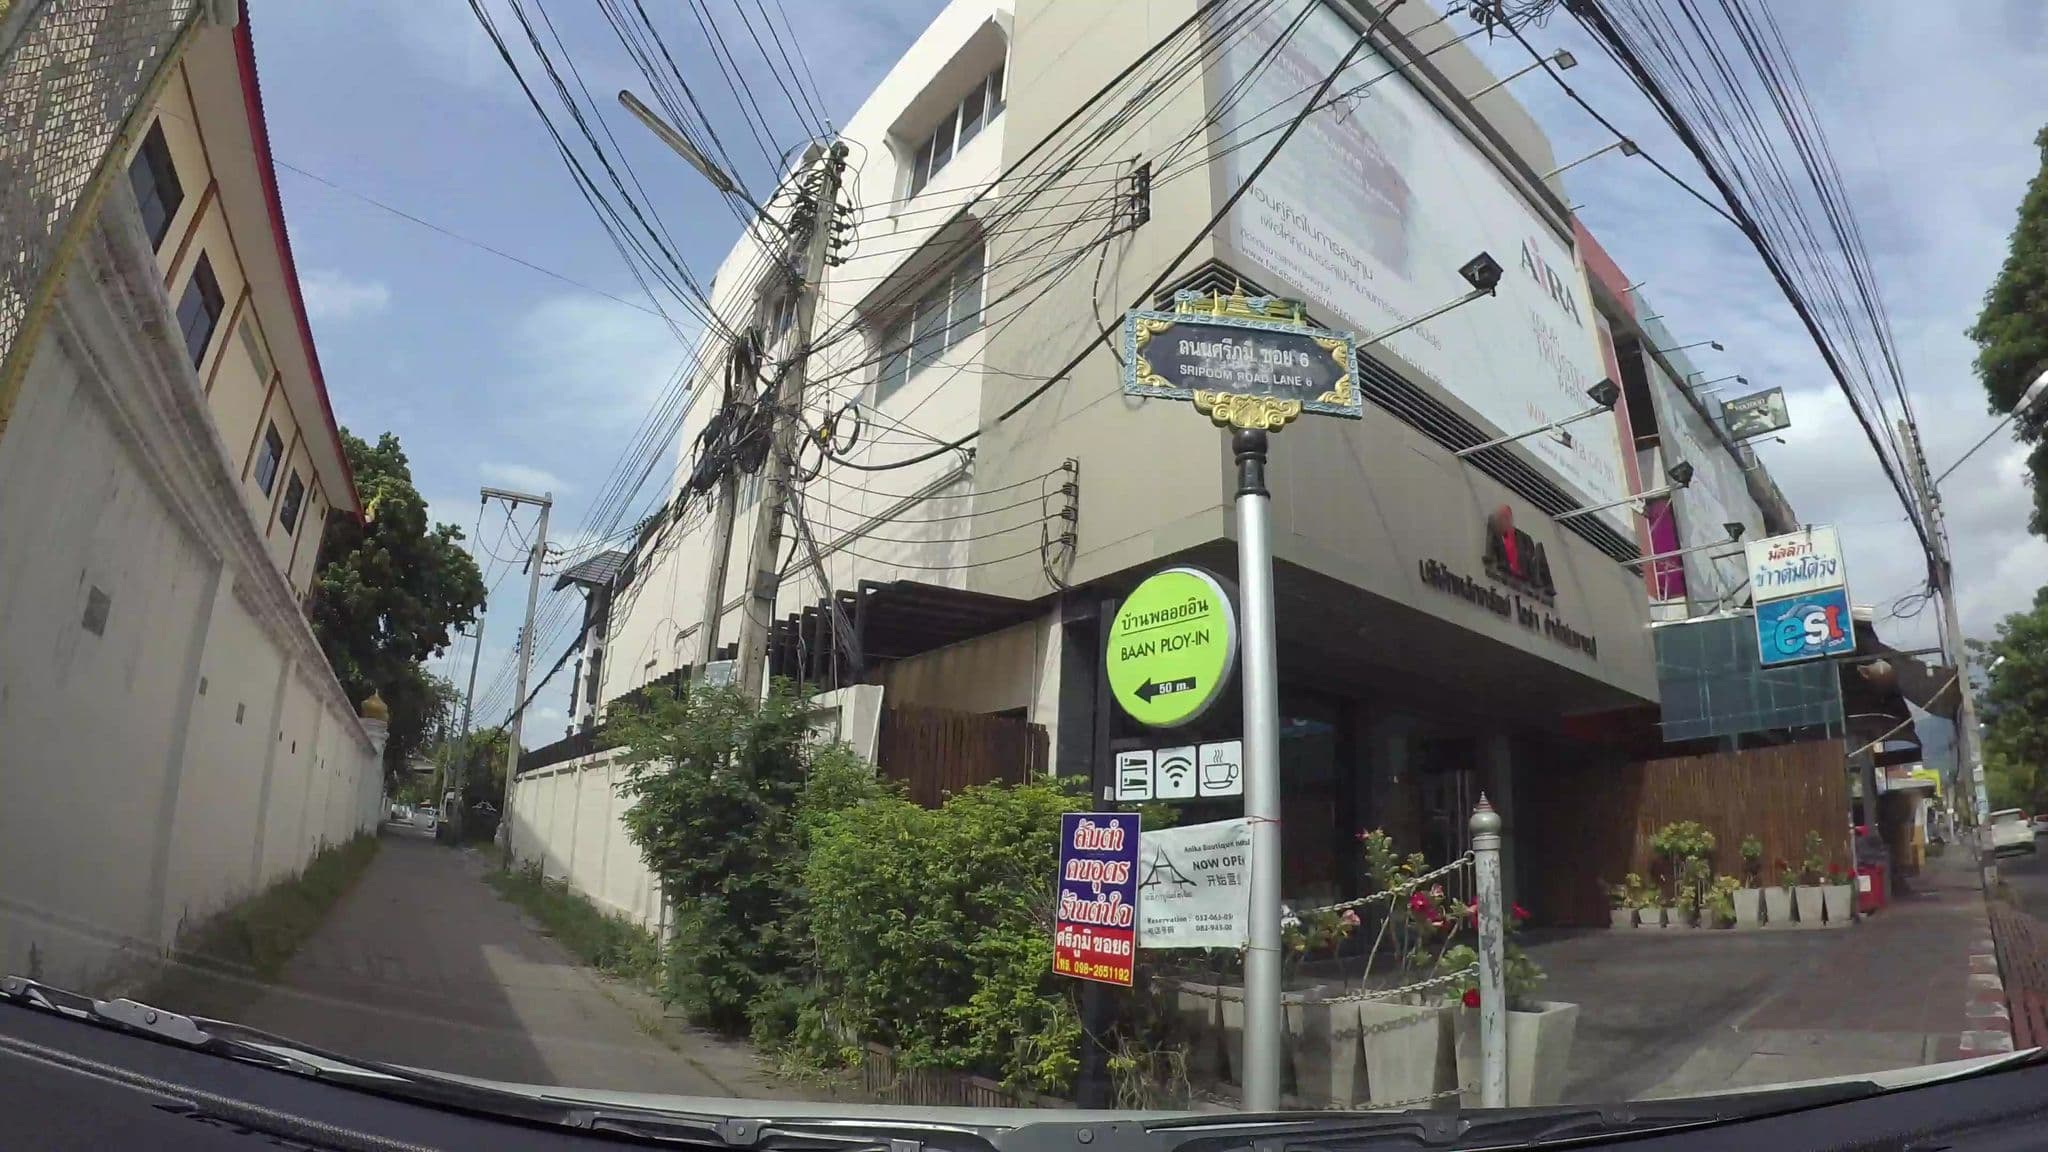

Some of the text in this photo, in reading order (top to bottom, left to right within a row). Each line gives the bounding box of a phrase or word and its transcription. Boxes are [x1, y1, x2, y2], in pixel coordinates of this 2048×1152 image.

[1263, 349, 1295, 367] ซอย
[1299, 351, 1309, 368] 6
[1180, 364, 1313, 387] SRIPOOM ROAD LANE 6
[1121, 597, 1209, 631] บ้านพลอยอิน
[1775, 603, 1845, 655] est
[1121, 629, 1209, 661] BAAN PLOY-IN
[1159, 682, 1190, 694] 50 m.
[1065, 859, 1131, 894] คนอุดร
[1192, 857, 1220, 872] NOW
[1058, 889, 1134, 927] ร้านตำใจ
[1057, 925, 1092, 957] ศรีภูมิ
[1056, 952, 1071, 973] โทร.
